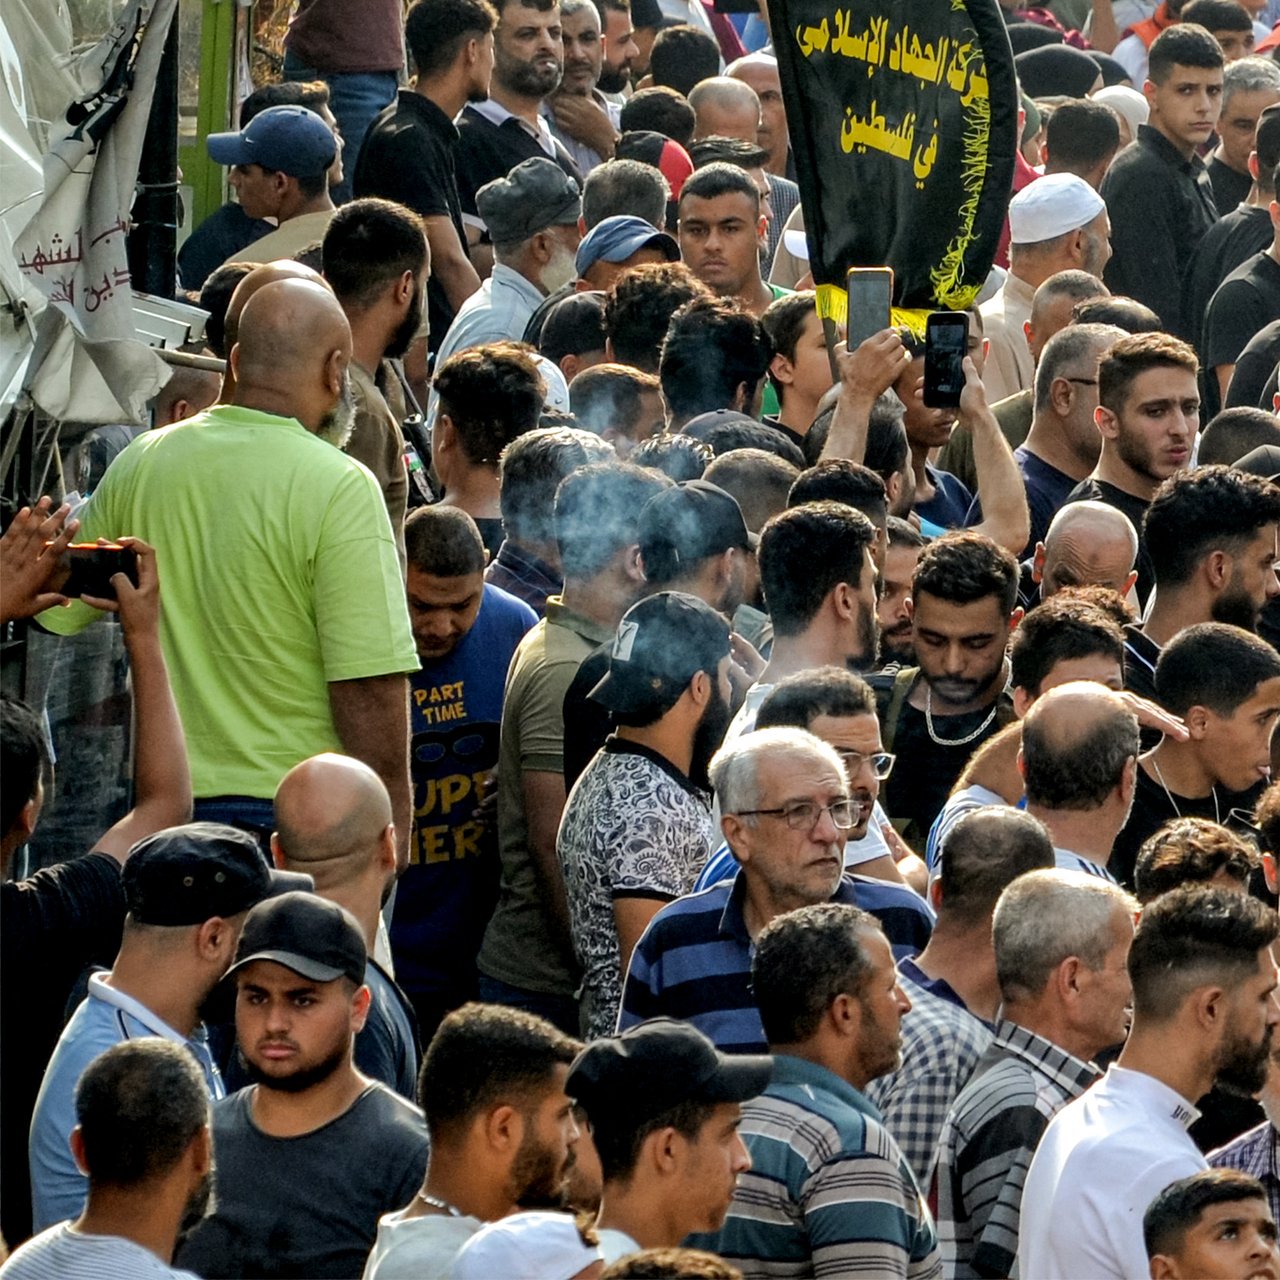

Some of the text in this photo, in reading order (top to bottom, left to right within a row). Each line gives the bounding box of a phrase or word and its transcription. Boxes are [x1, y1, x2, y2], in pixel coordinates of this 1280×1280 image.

[888, 23, 950, 91] الجهاد
[840, 98, 939, 190] في فلسطين
[413, 681, 465, 706] PART
[421, 701, 468, 725] TIME
